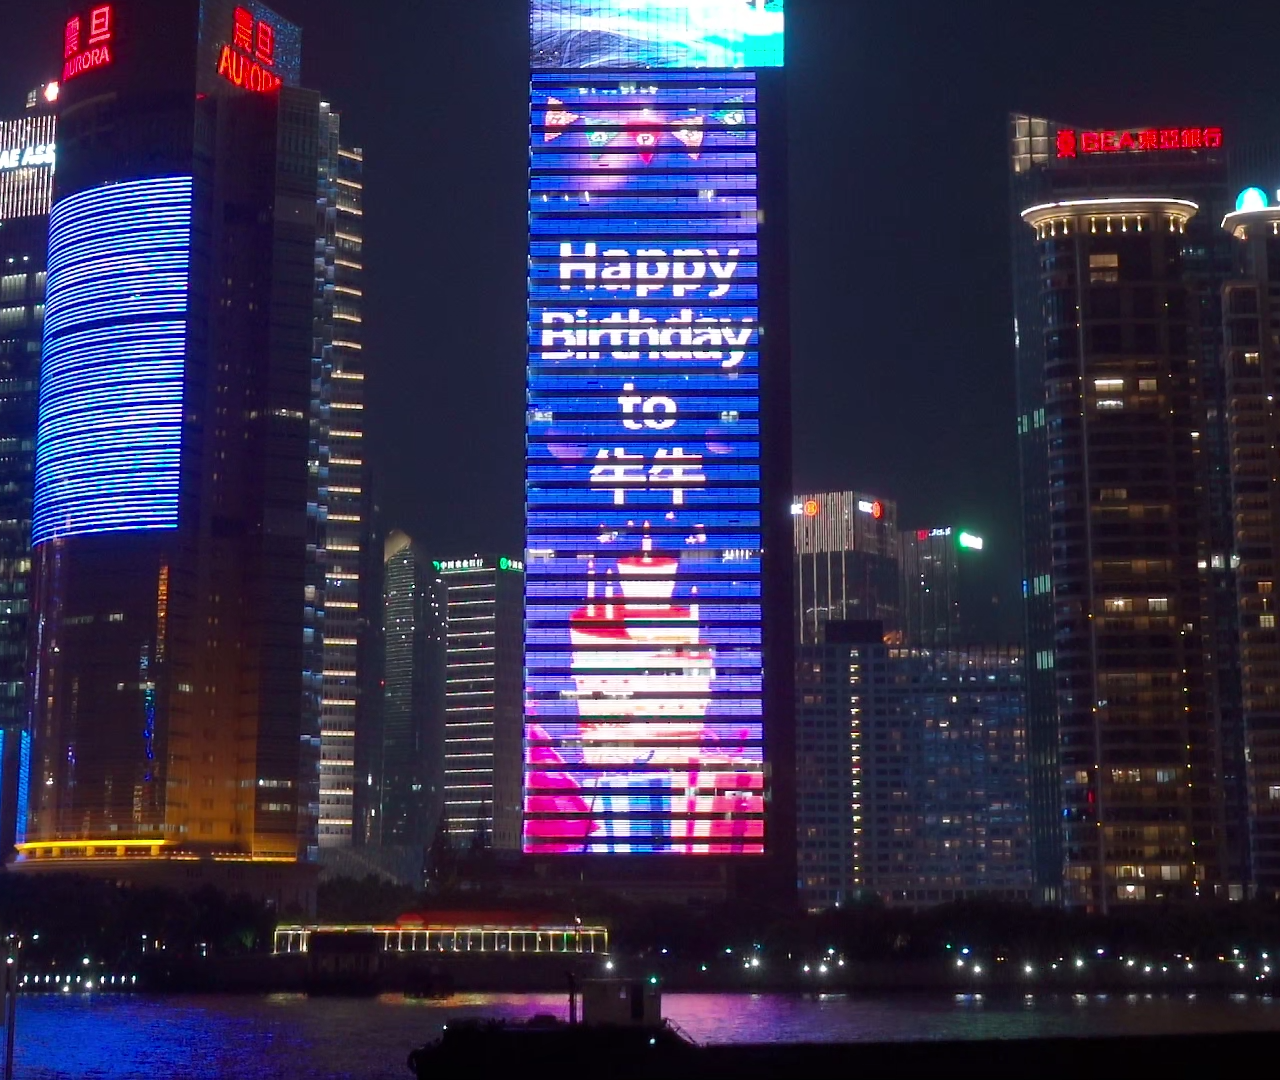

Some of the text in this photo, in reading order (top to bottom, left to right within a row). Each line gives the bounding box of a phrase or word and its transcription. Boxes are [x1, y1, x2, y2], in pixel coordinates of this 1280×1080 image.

[1081, 131, 1135, 152] BEA
[559, 242, 740, 297] Happy
[541, 308, 753, 367] Birthday
[618, 382, 677, 429] to
